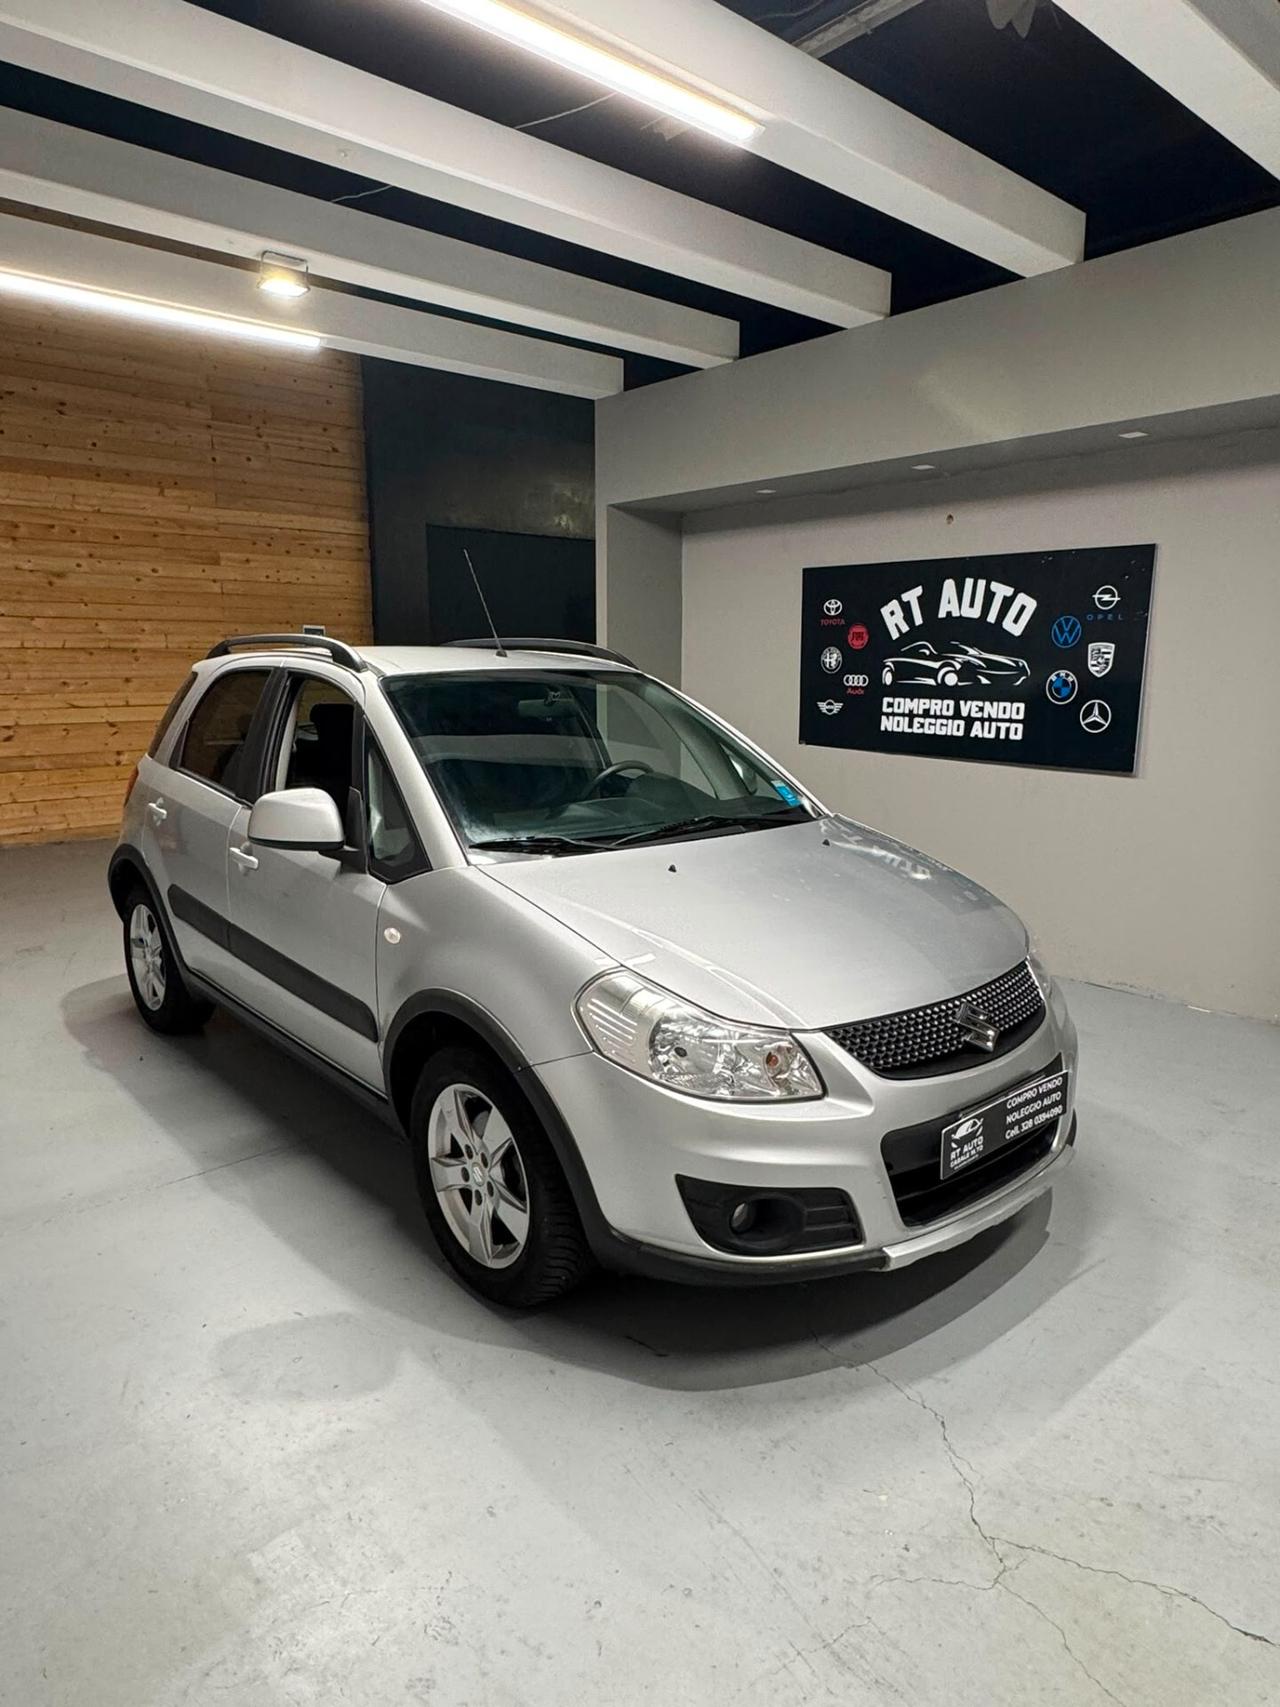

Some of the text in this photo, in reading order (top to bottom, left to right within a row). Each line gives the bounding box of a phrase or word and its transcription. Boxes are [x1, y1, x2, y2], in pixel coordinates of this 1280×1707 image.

[880, 577, 1038, 641] RT AUTO
[1086, 613, 1124, 621] OPEL
[820, 618, 846, 626] TOYOTA
[846, 687, 865, 695] Audi
[882, 696, 1025, 720] COMPRO VENDO
[880, 715, 1024, 740] NOLEGGIO AUTO
[1006, 1077, 1063, 1109] COMPRO VENDO
[1006, 1091, 1062, 1125] NOLEGGIO AUTO
[963, 1135, 984, 1154] AUTO
